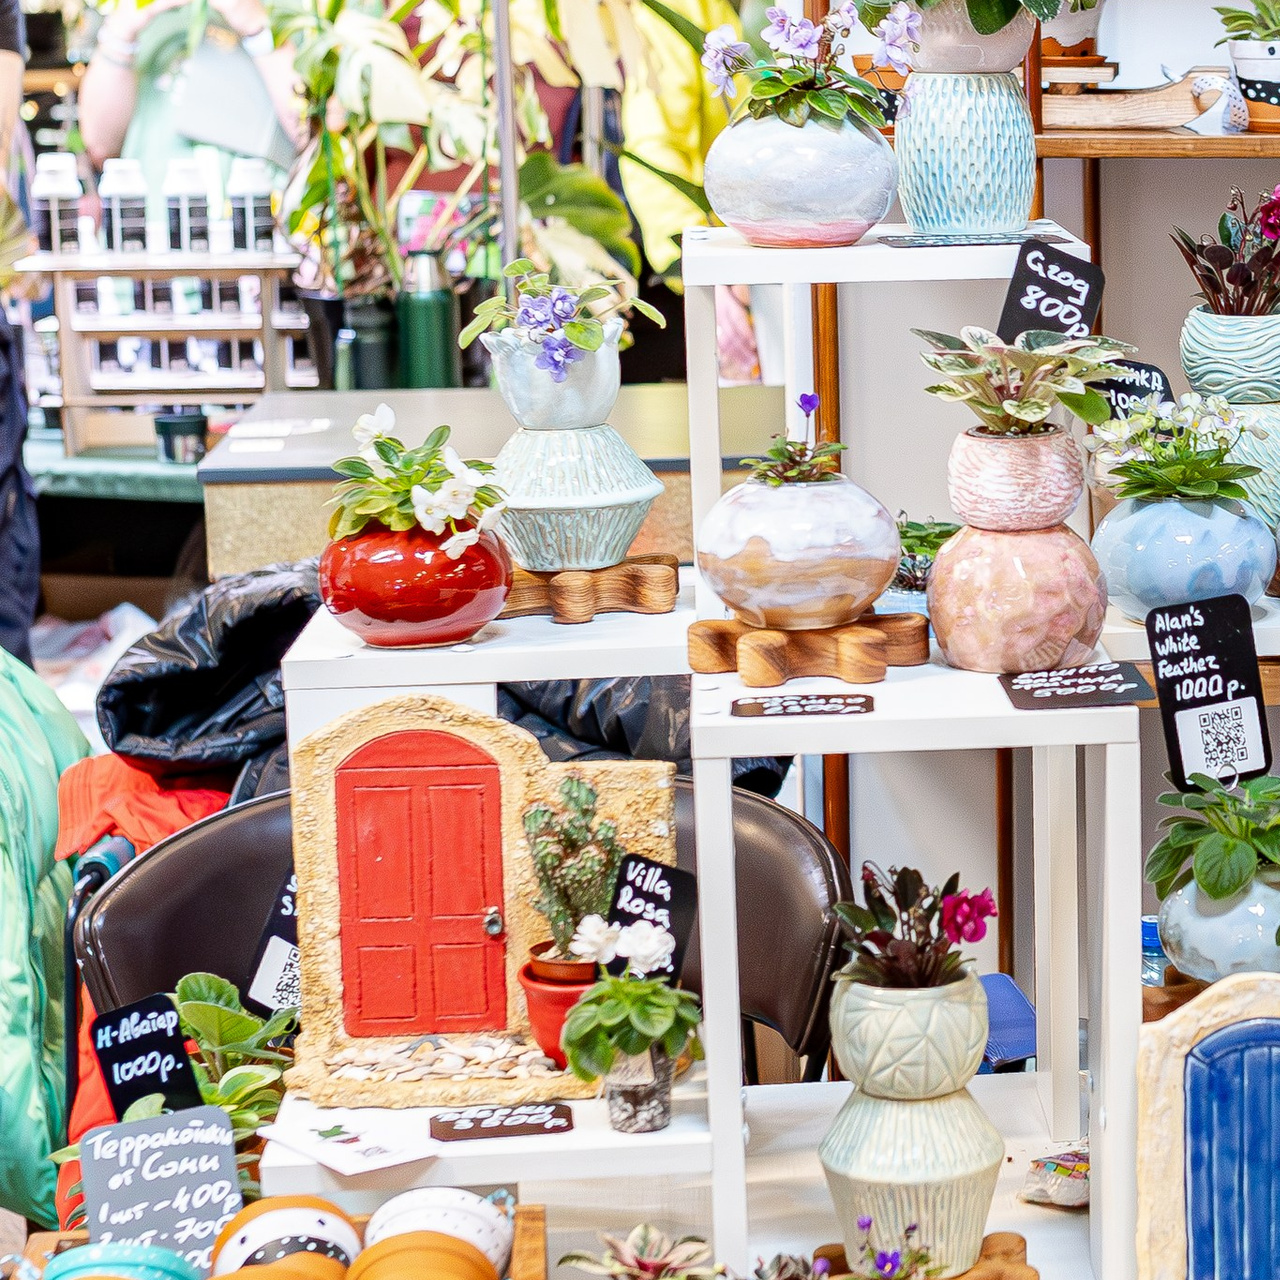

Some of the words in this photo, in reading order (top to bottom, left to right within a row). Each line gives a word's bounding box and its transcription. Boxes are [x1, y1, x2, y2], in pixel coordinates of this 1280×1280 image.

[1155, 606, 1205, 634] Alan's
[1155, 632, 1201, 657] White
[1157, 655, 1221, 680] Feather
[626, 861, 672, 902] Villa
[617, 885, 670, 928] Rosa
[107, 1168, 136, 1190] от
[141, 1151, 220, 1181] Сони
